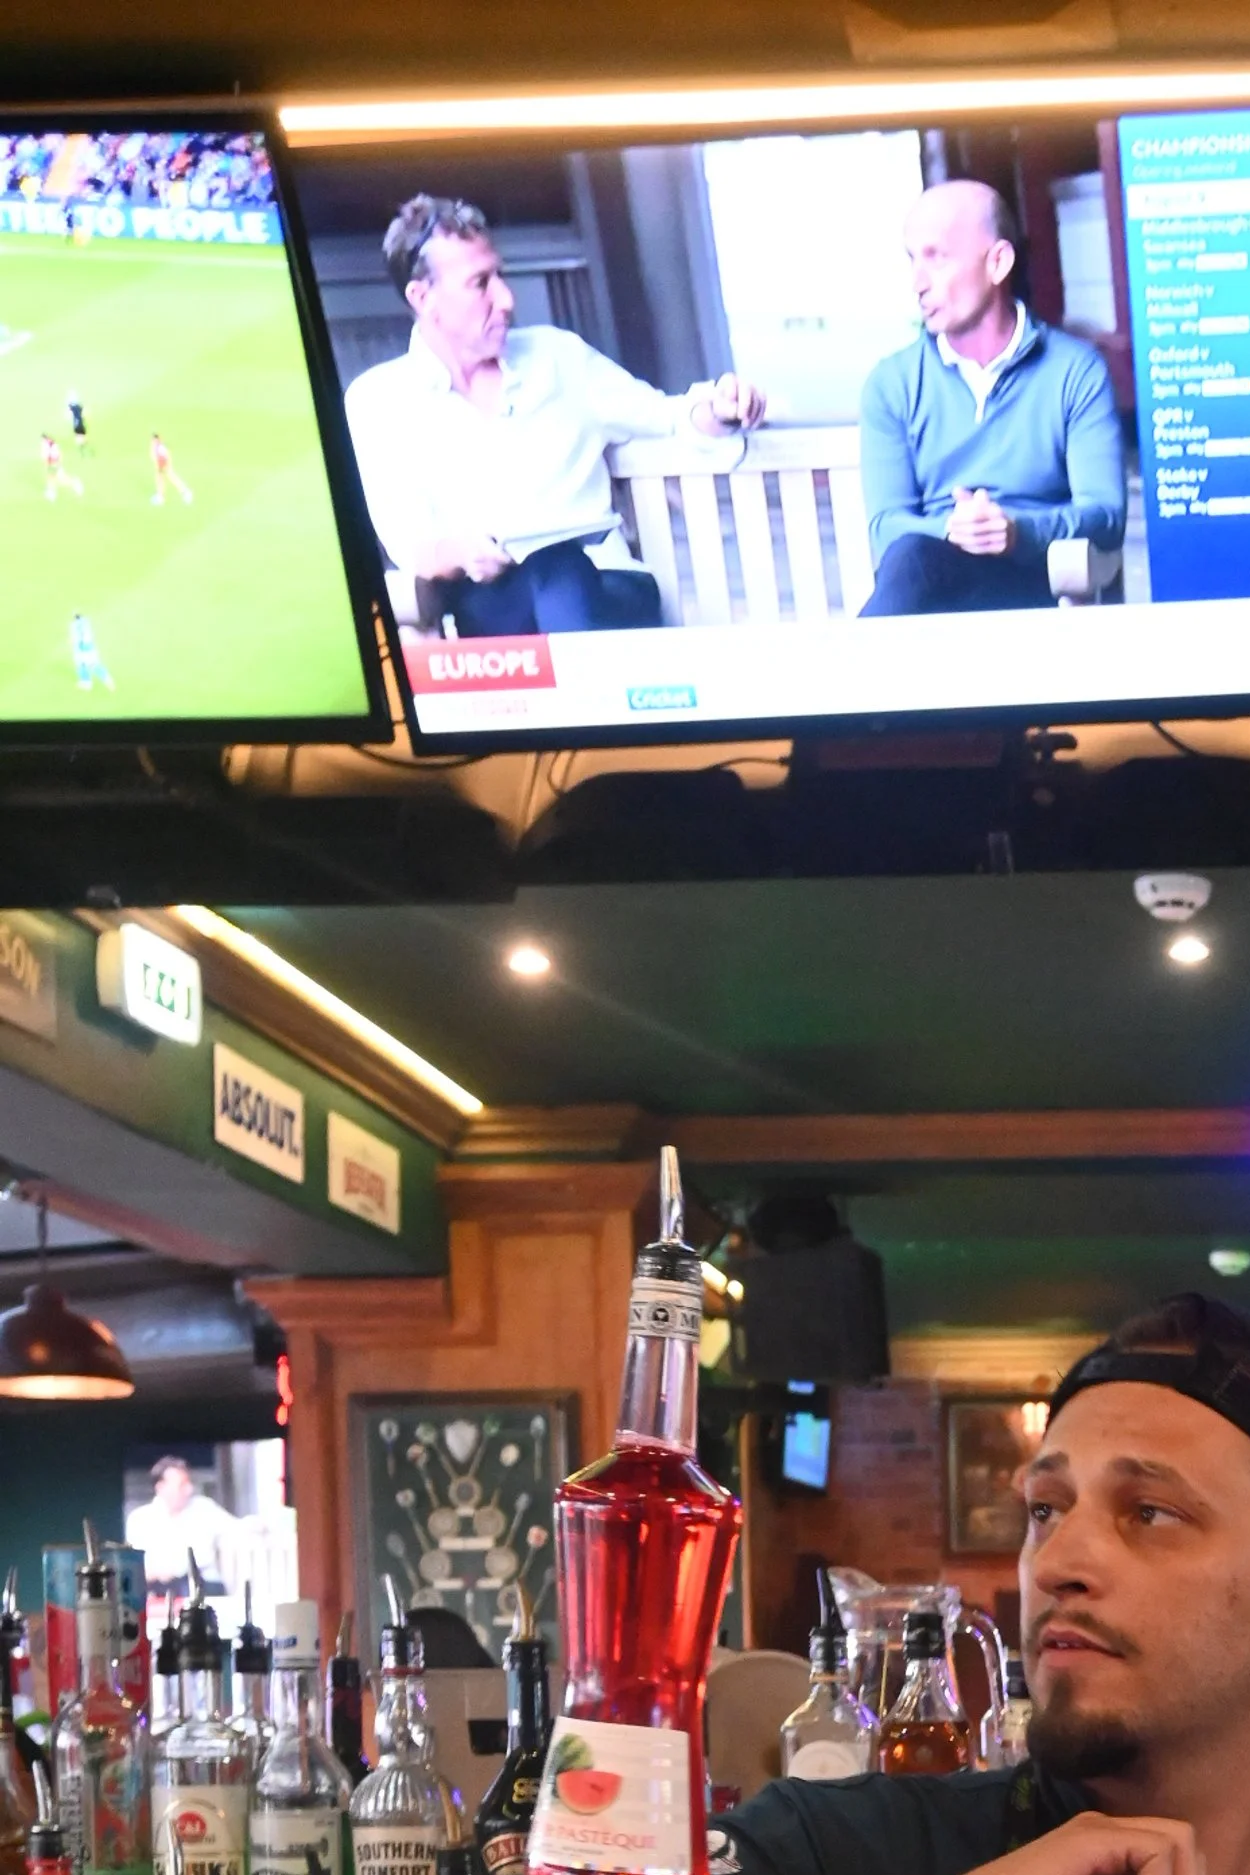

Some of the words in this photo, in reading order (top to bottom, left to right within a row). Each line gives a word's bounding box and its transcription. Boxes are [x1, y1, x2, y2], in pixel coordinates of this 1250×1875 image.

[130, 208, 270, 243] PEOPLE
[427, 649, 539, 681] EUROPE
[358, 1841, 436, 1862] SOUTHERN
